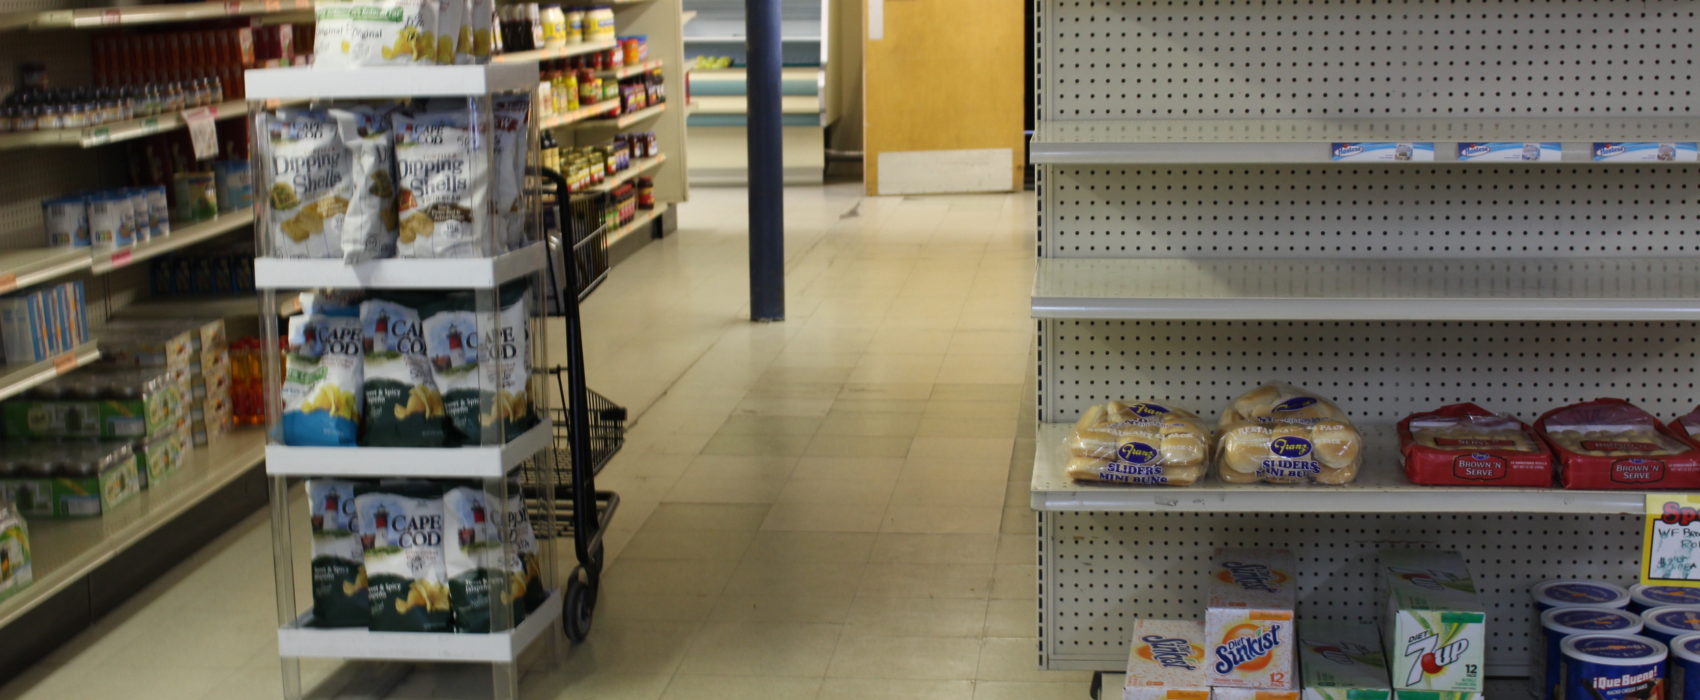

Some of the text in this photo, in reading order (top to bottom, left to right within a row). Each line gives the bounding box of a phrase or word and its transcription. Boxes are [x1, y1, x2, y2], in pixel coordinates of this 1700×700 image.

[417, 134, 443, 145] COD
[272, 151, 340, 176] Dipping
[292, 174, 343, 194] Shells
[410, 175, 467, 199] Shells
[319, 327, 361, 341] CAPE
[1121, 444, 1154, 461] Franz
[1273, 438, 1308, 454] Franz
[1107, 463, 1162, 475] SLIDERS
[1262, 460, 1318, 470] SLIDERS
[1458, 460, 1491, 469] BROWN
[1616, 465, 1649, 473] BROWN
[1465, 468, 1493, 477] SERVE
[1623, 471, 1650, 480] SERVE
[392, 515, 441, 532] CAPE
[1658, 528, 1679, 537] WF
[399, 531, 441, 548] COD
[1228, 636, 1244, 650] Diet
[1408, 630, 1429, 643] DIET
[1215, 624, 1280, 674] Sunkist
[1465, 664, 1477, 674] 12
[1622, 665, 1658, 686] Bueno!
[1270, 672, 1284, 682] 12
